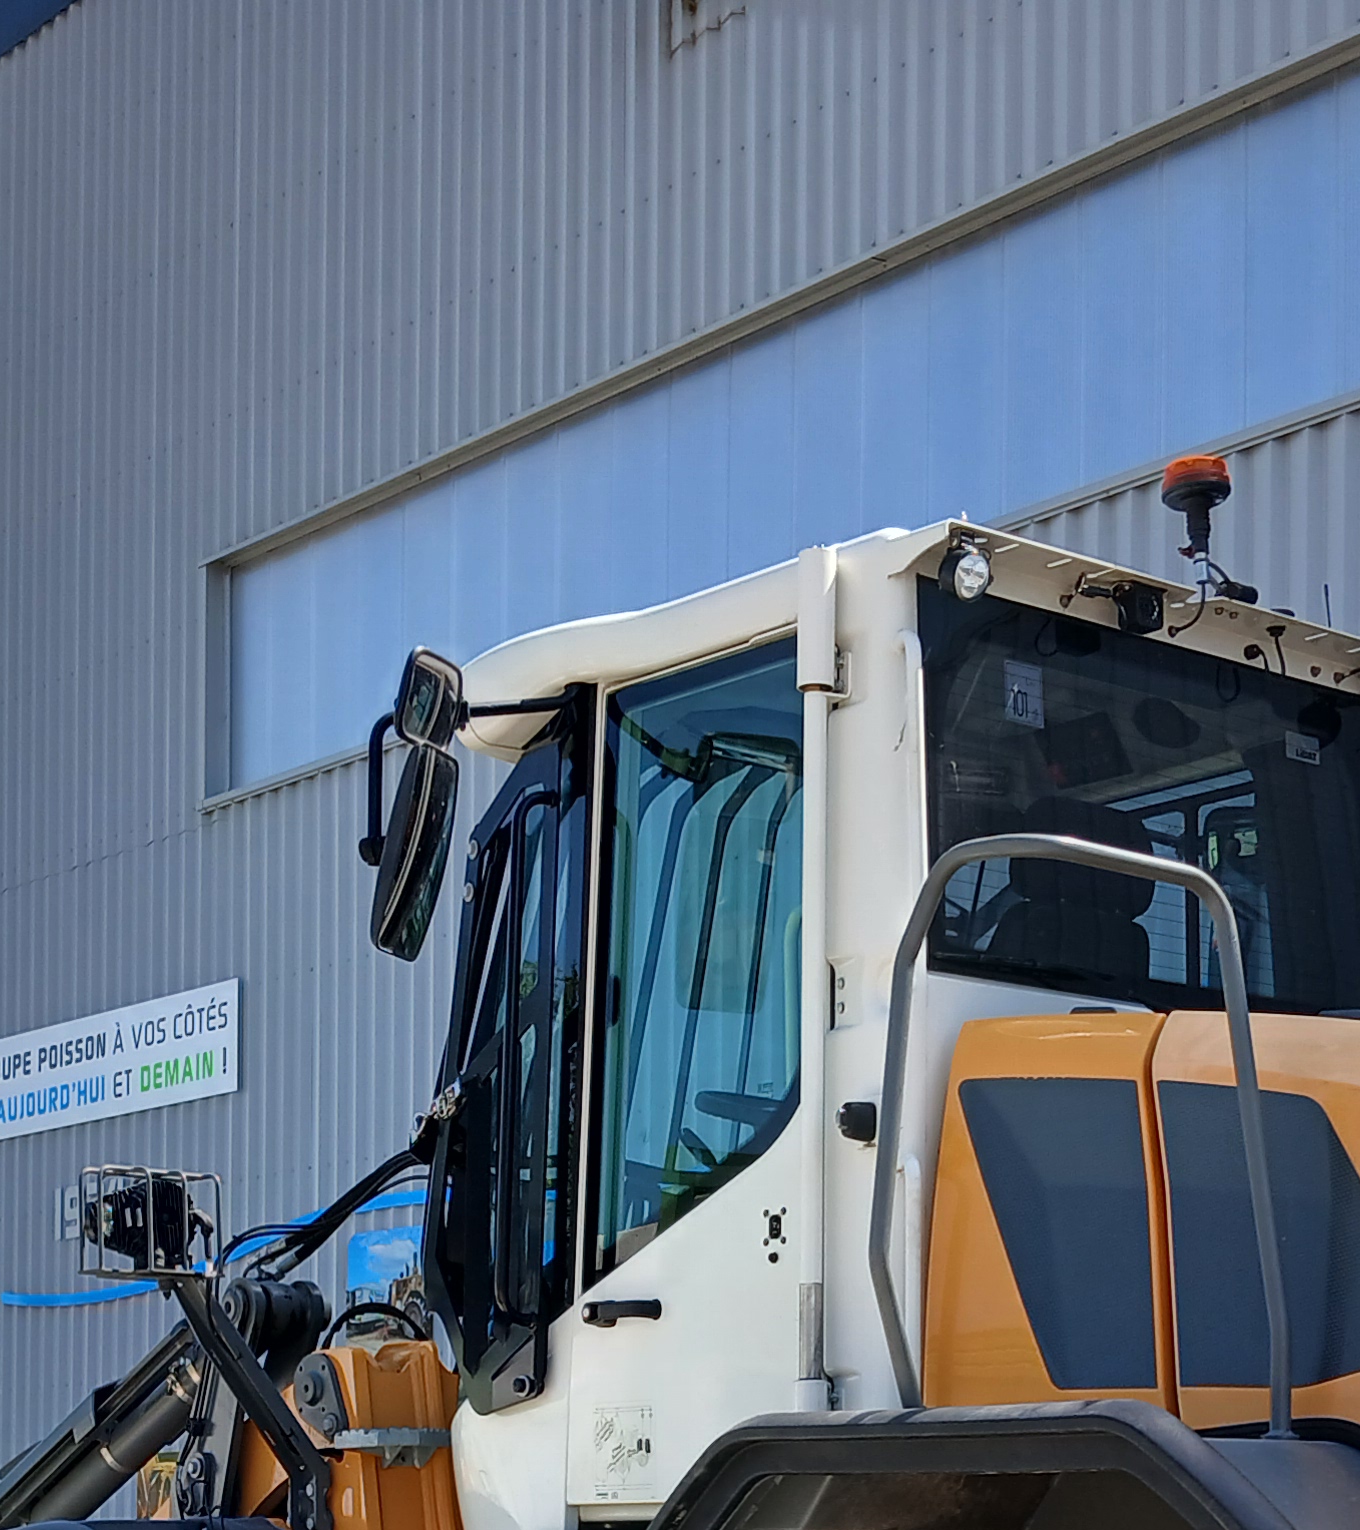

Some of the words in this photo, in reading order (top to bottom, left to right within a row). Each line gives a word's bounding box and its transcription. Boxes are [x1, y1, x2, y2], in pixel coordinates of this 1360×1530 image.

[37, 1032, 107, 1073] POISSON
[112, 1021, 125, 1055] À
[131, 1017, 167, 1049] VOS
[173, 997, 229, 1041] CÔTÉS
[113, 1068, 133, 1098] ET
[140, 1049, 215, 1093] DEMAIN
